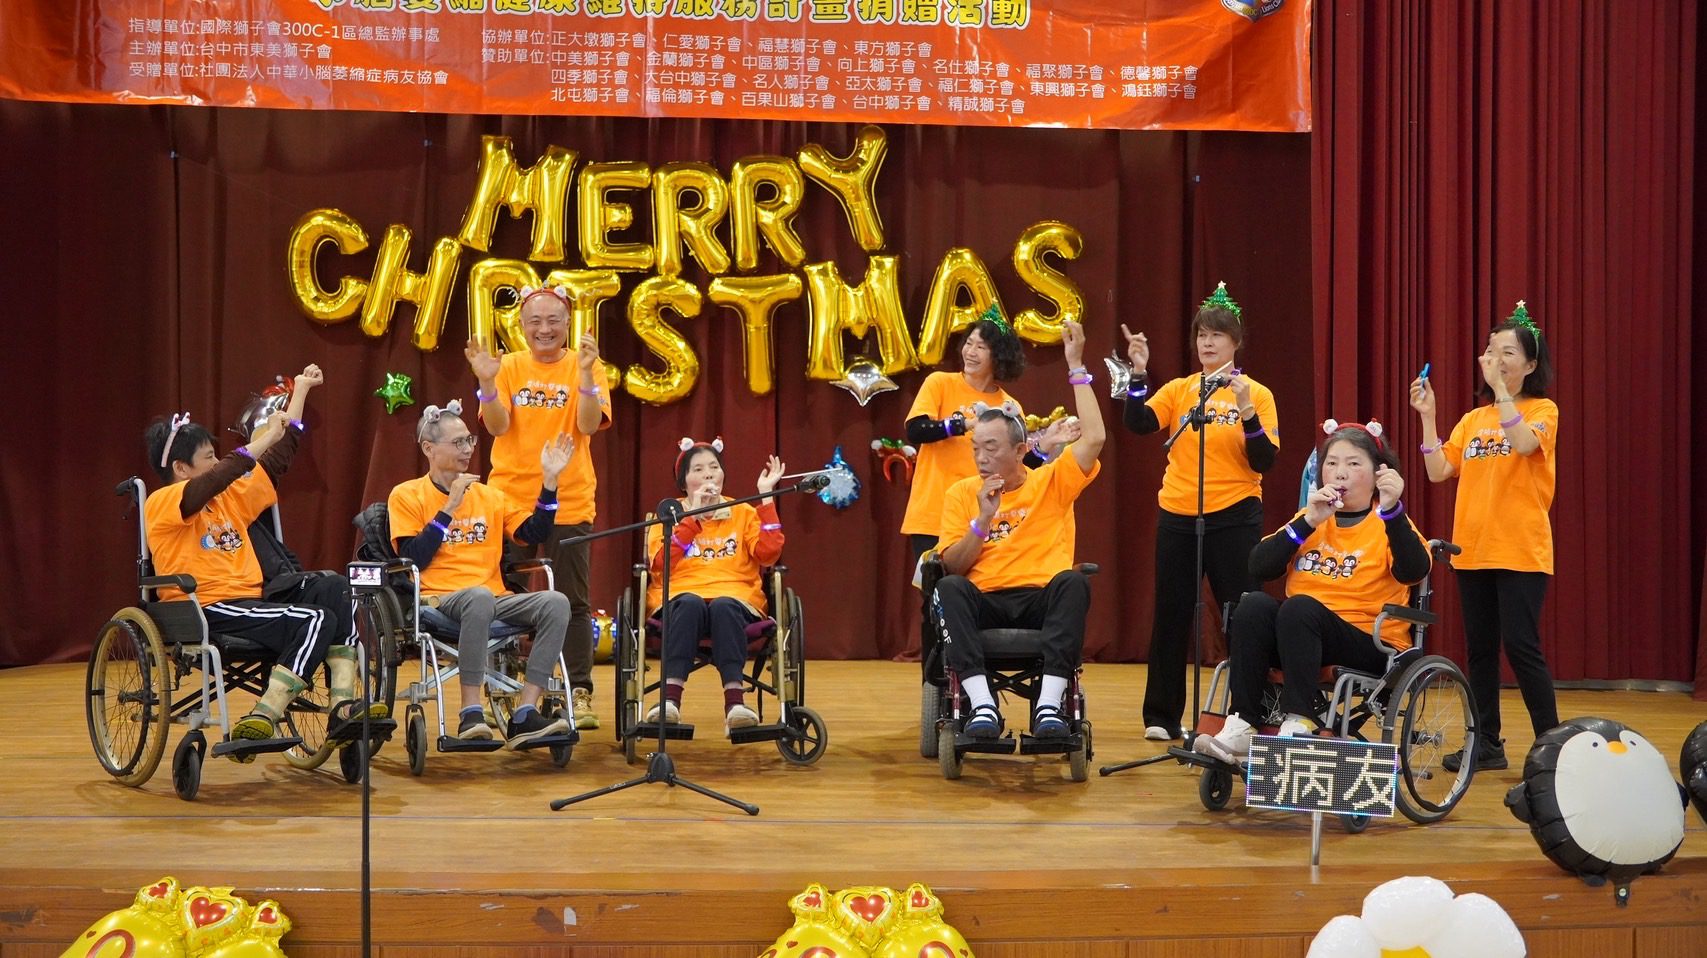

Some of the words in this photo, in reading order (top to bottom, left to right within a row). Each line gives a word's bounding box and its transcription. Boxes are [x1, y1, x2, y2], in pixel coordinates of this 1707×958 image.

[128, 40, 332, 60] 主辦單位:台中市東美獅子會
[459, 126, 889, 275] MERRY
